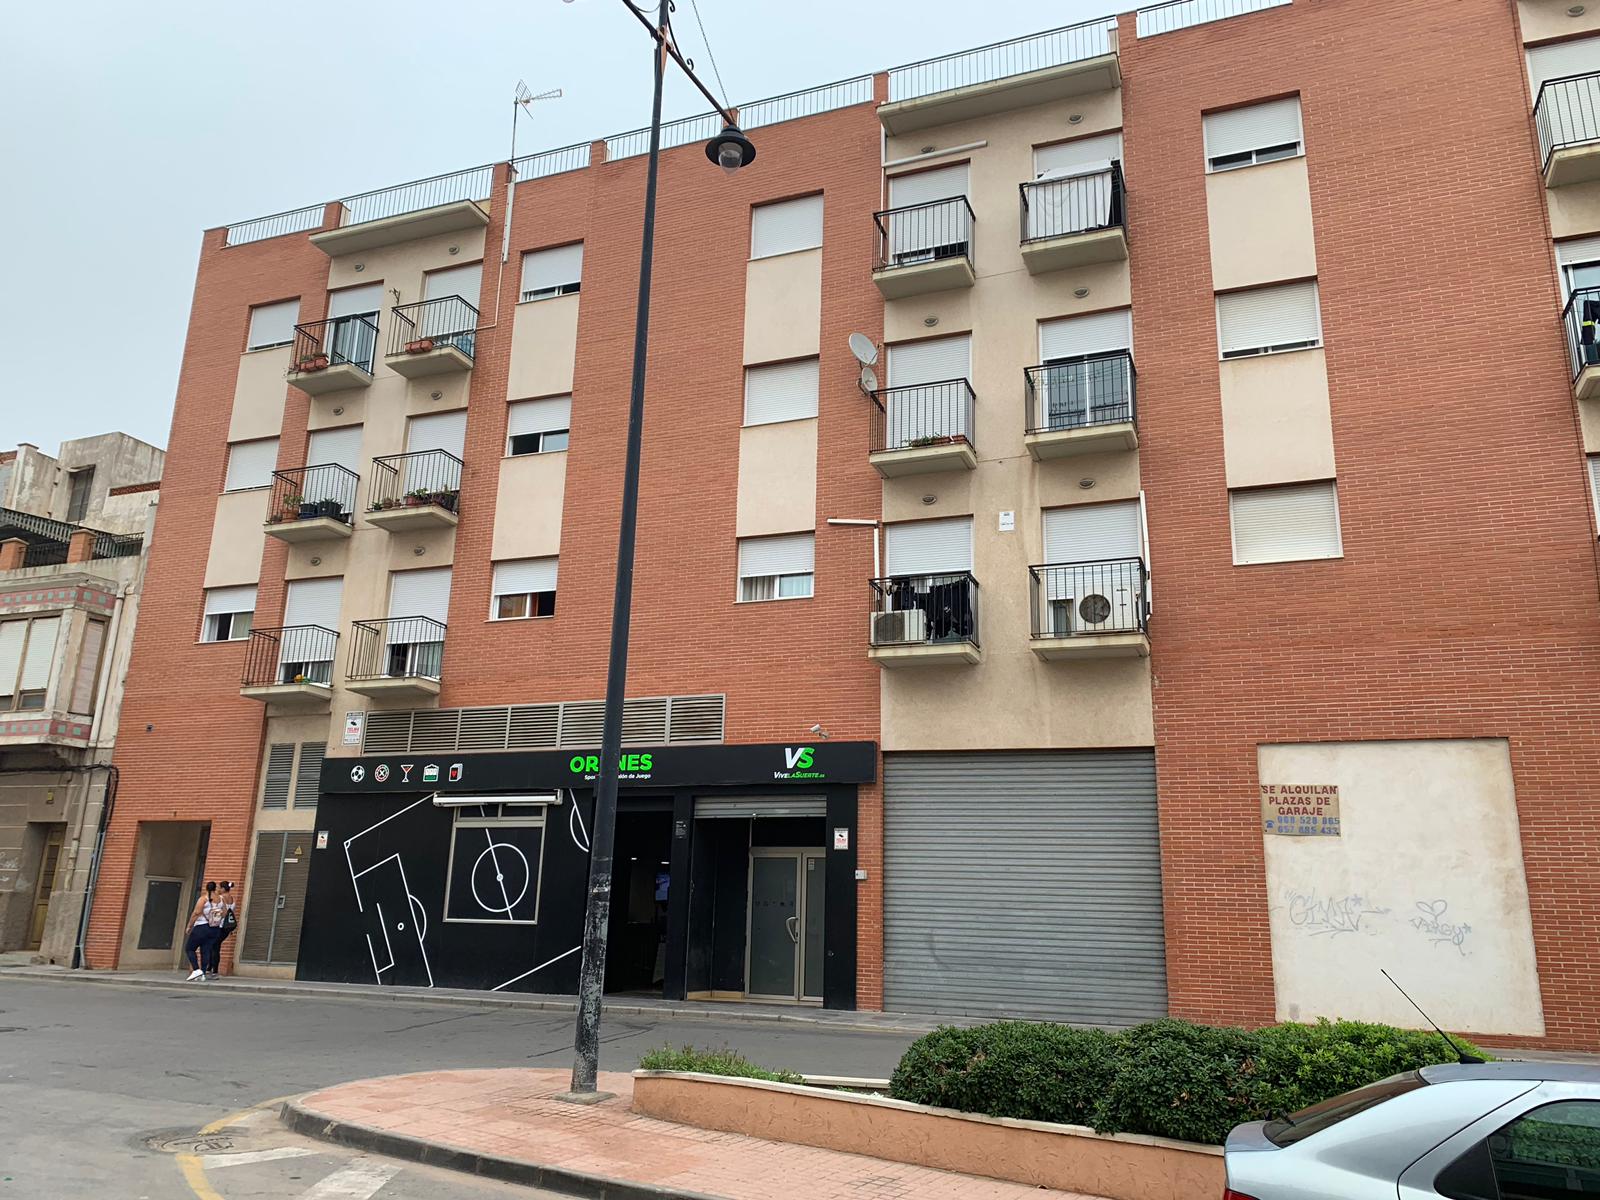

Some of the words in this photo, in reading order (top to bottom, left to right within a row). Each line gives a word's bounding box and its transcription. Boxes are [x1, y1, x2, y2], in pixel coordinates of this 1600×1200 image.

[784, 747, 815, 769] VS
[1262, 785, 1275, 794] SE
[1280, 785, 1337, 795] ALQUILAN
[1269, 797, 1311, 805] PLAZAS
[1316, 797, 1331, 805] DE
[1278, 807, 1323, 816] GARAJE
